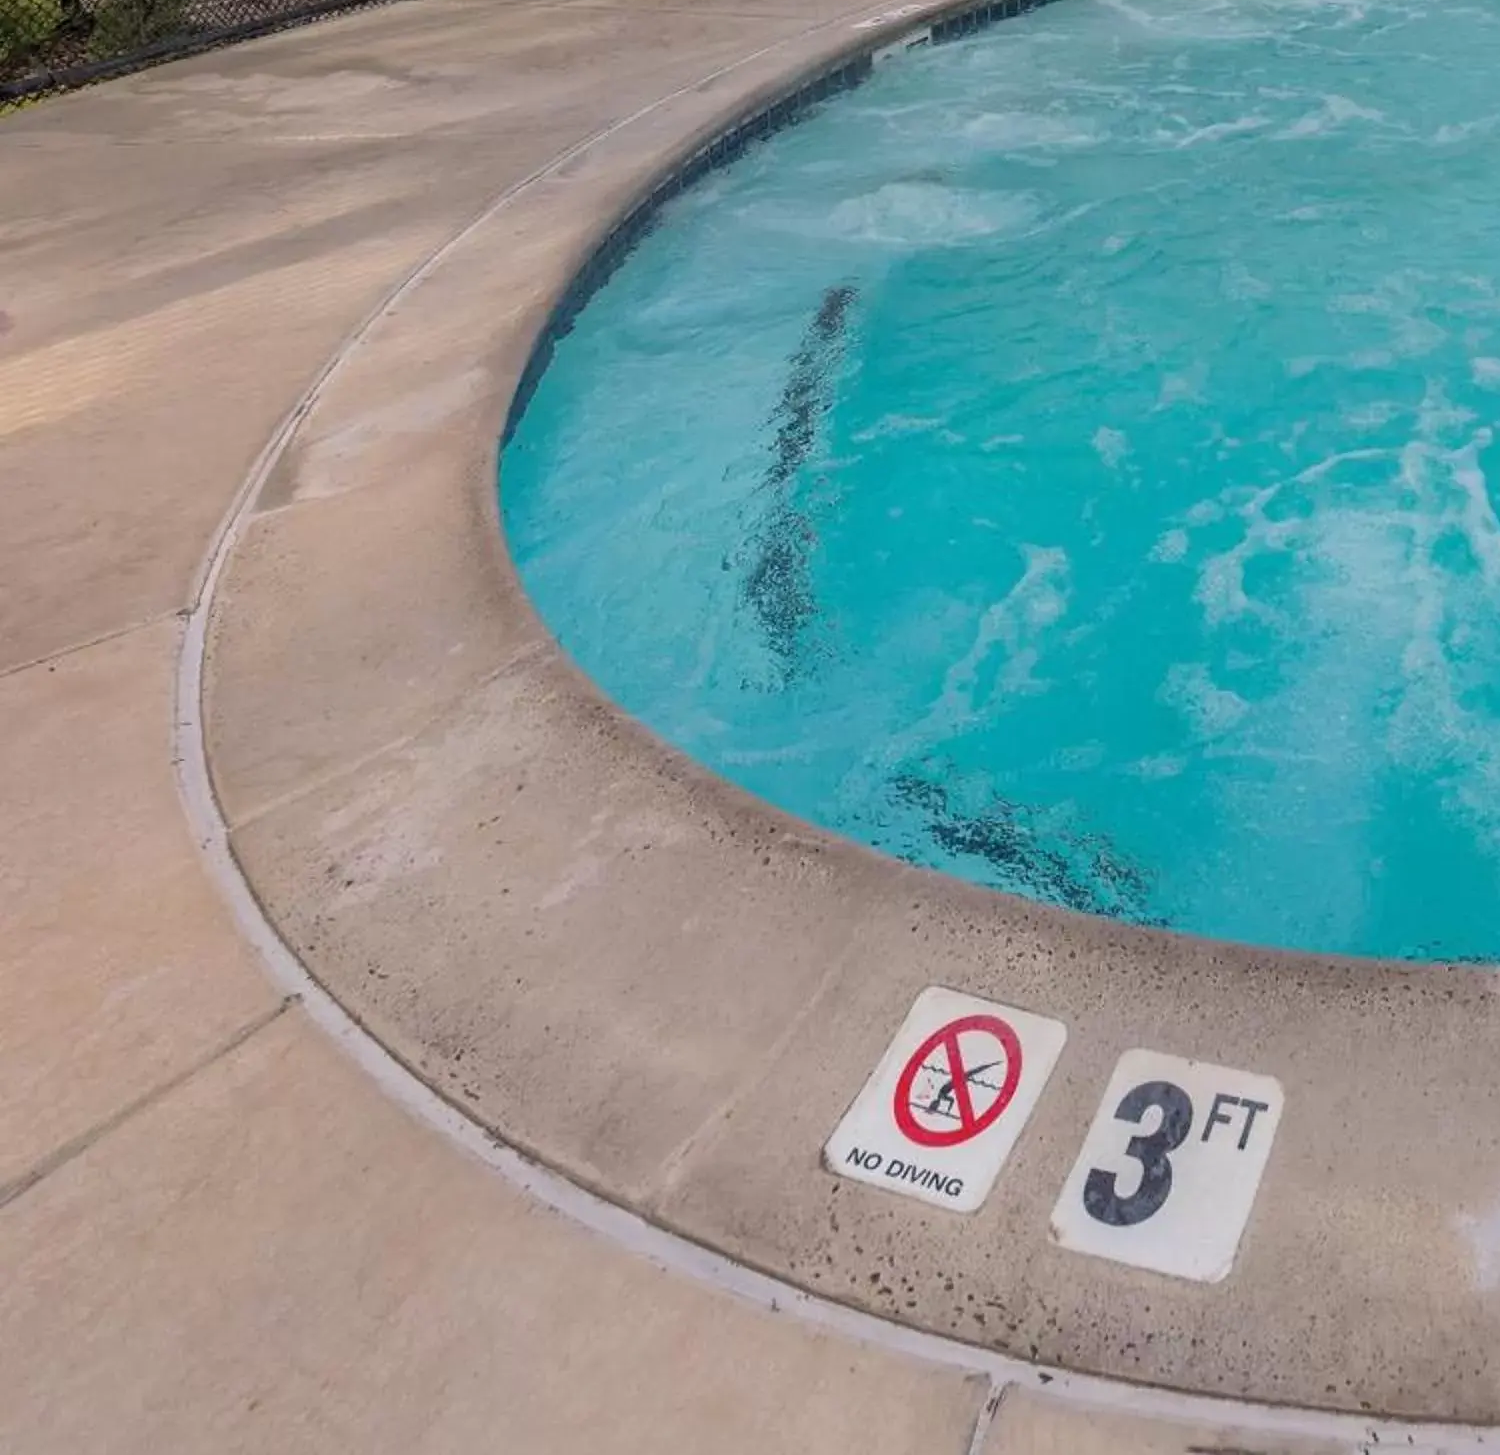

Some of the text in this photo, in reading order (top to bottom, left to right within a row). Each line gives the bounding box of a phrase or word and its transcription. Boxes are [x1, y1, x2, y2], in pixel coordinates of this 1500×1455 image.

[845, 1147, 965, 1197] NO DIVING
[1083, 1080, 1269, 1227] 3 FT
